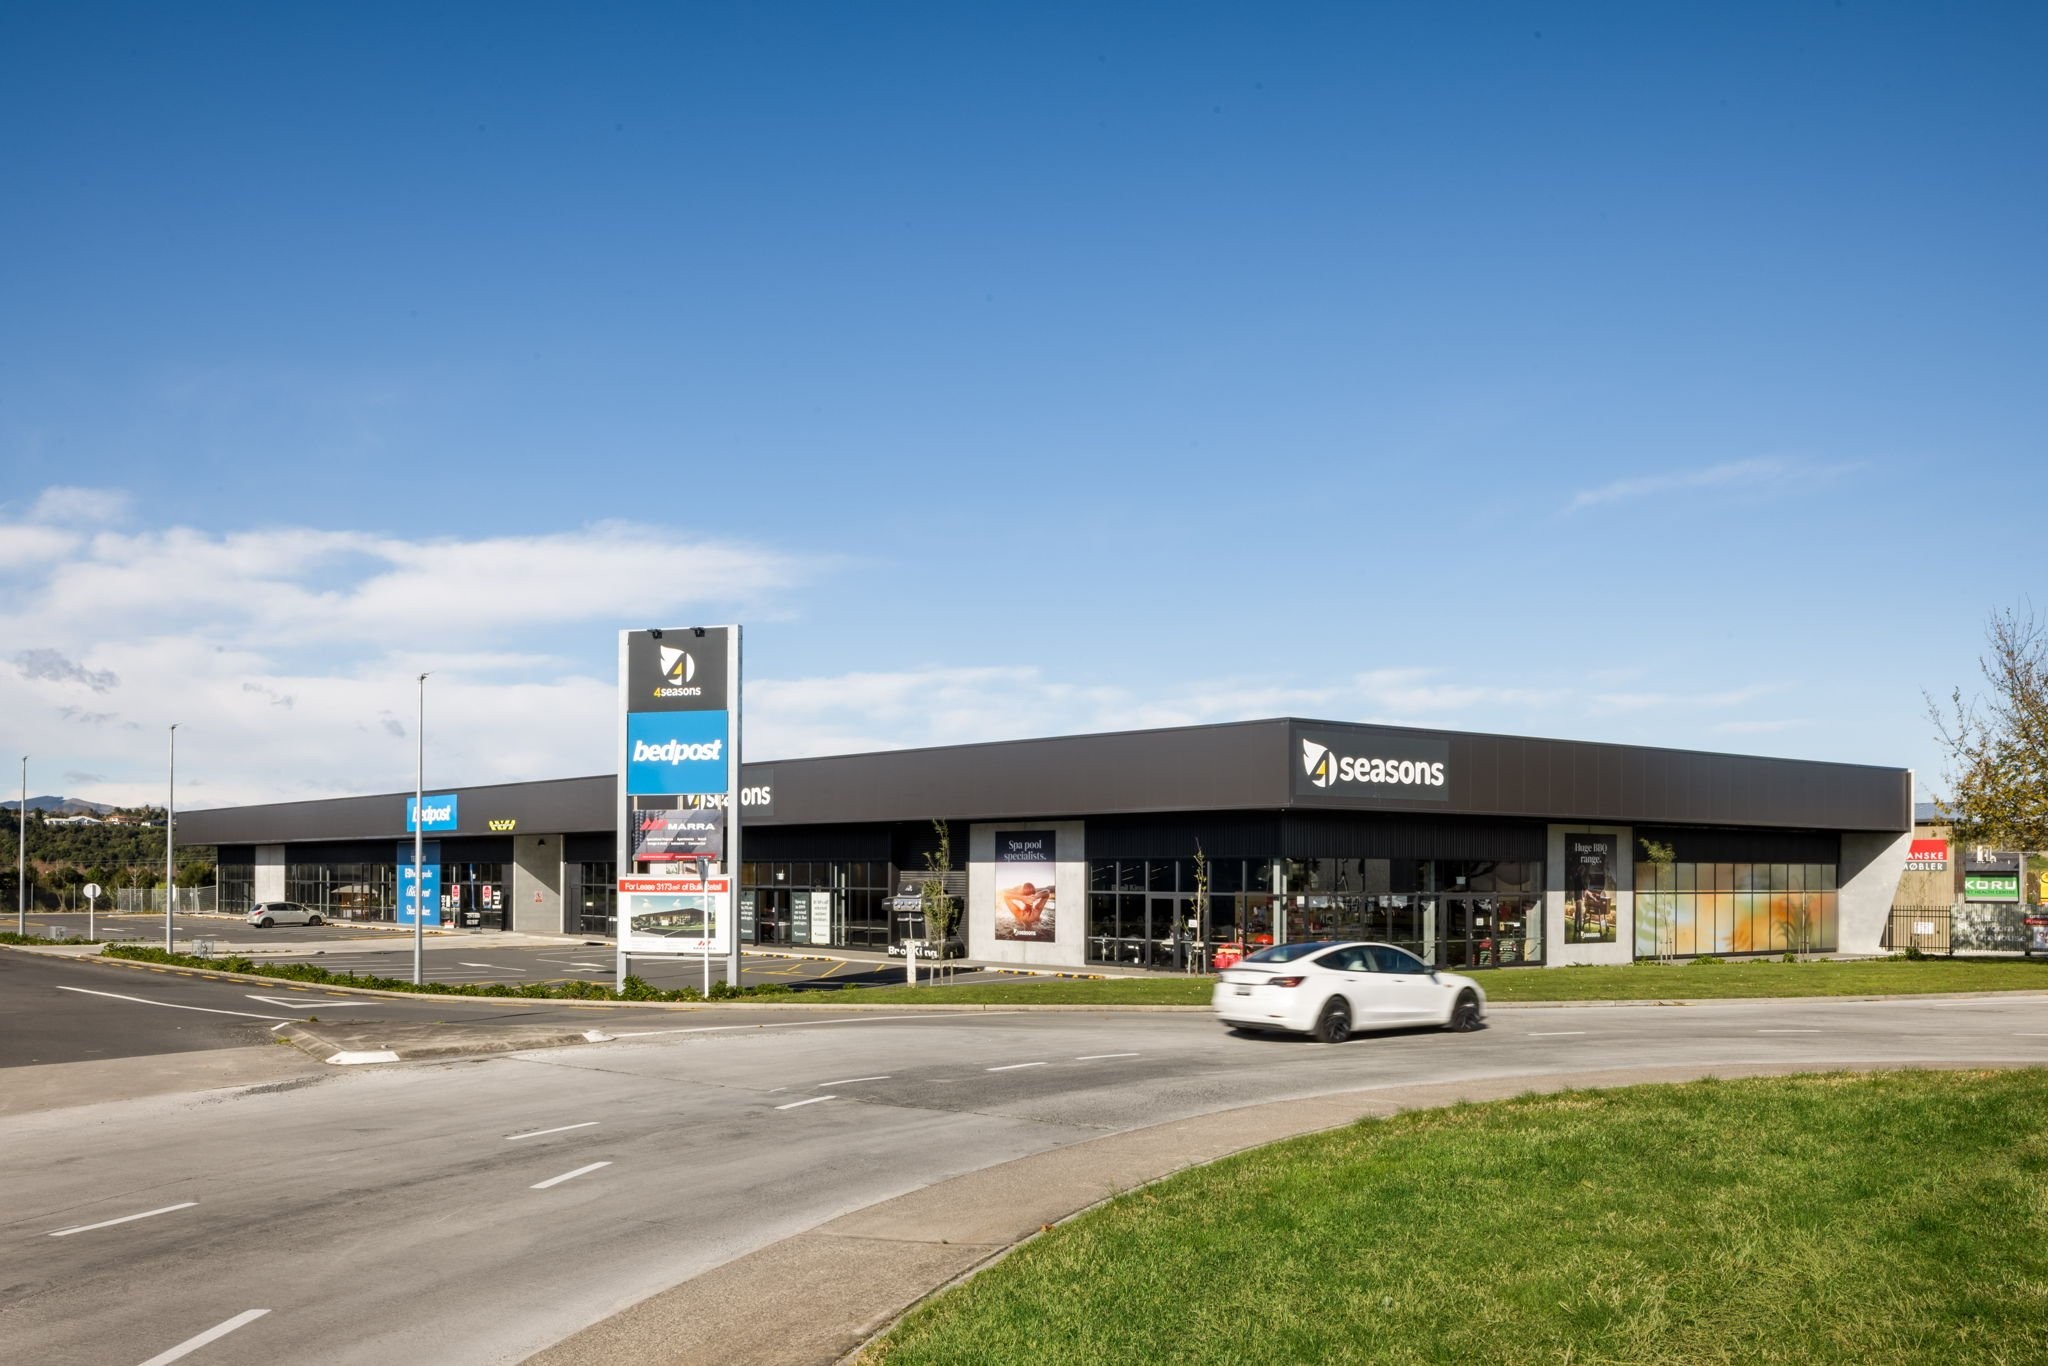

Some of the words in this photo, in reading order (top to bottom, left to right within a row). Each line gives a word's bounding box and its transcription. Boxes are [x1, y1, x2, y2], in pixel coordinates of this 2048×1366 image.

[653, 686, 701, 698] 4seasons
[633, 739, 722, 765] bedpost
[1340, 756, 1445, 786] seasons
[668, 822, 716, 831] MARRA
[1008, 839, 1023, 852] Spa
[1024, 839, 1042, 852] pool
[1574, 842, 1593, 855] Huge
[1593, 843, 1608, 855] BBQ
[1003, 851, 1047, 863] specialists.
[1580, 855, 1602, 865] range.
[1907, 851, 1944, 860] ANSKE
[624, 882, 635, 891] For
[635, 883, 656, 891] Lease
[681, 883, 689, 891] of
[1964, 880, 2016, 890] KORU
